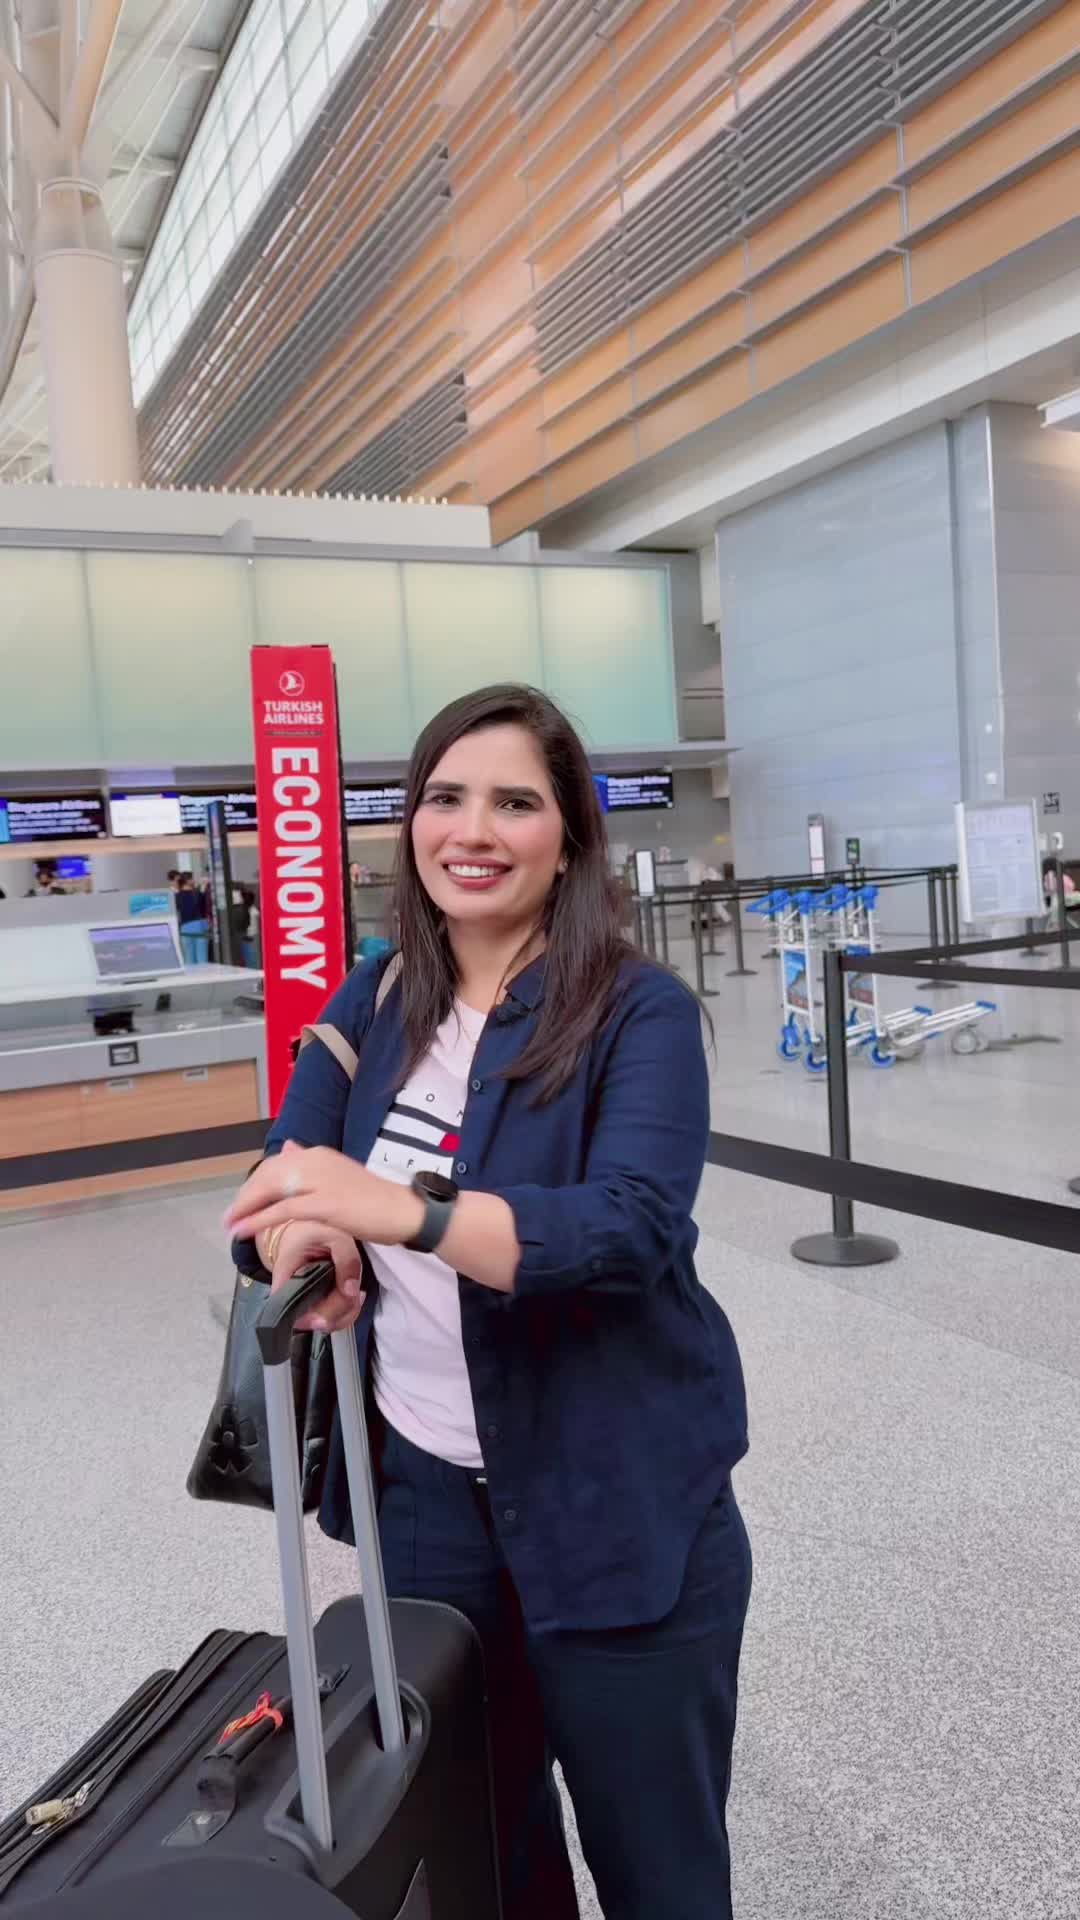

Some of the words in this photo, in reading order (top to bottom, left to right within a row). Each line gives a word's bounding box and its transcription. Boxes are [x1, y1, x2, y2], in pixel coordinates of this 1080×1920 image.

[263, 700, 323, 713] TURKISH
[263, 712, 325, 725] AIRLINES
[271, 747, 328, 990] ECONOMY
